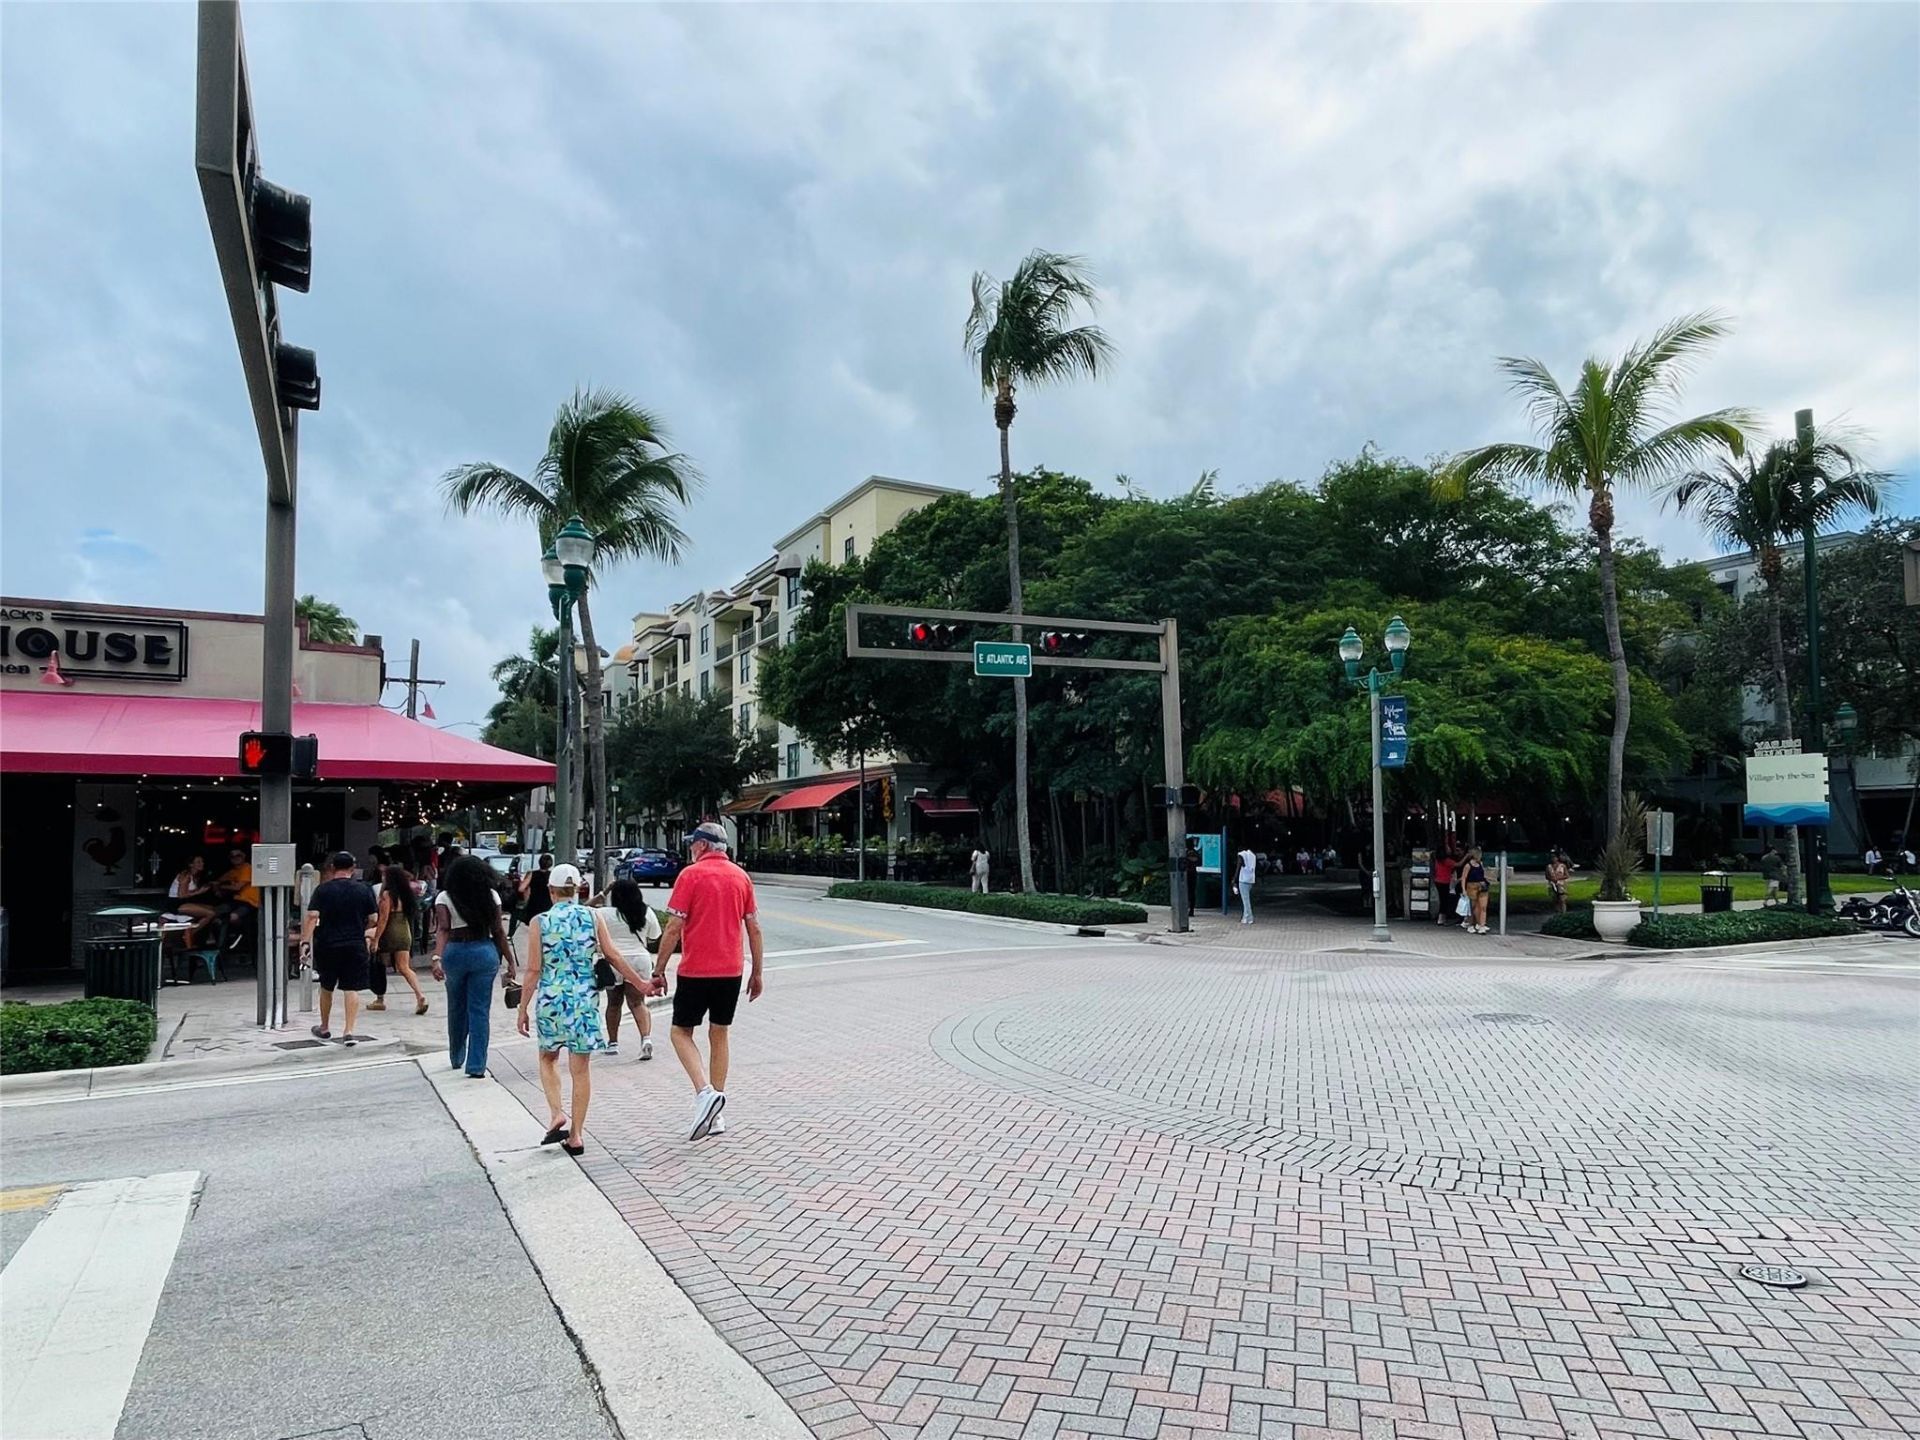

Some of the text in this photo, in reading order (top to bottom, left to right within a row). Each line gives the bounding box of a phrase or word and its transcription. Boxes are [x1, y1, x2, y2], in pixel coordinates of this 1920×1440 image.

[979, 653, 1028, 665] E ATLANTIC AVE
[1749, 774, 1774, 782] Village
[1776, 773, 1784, 781] by
